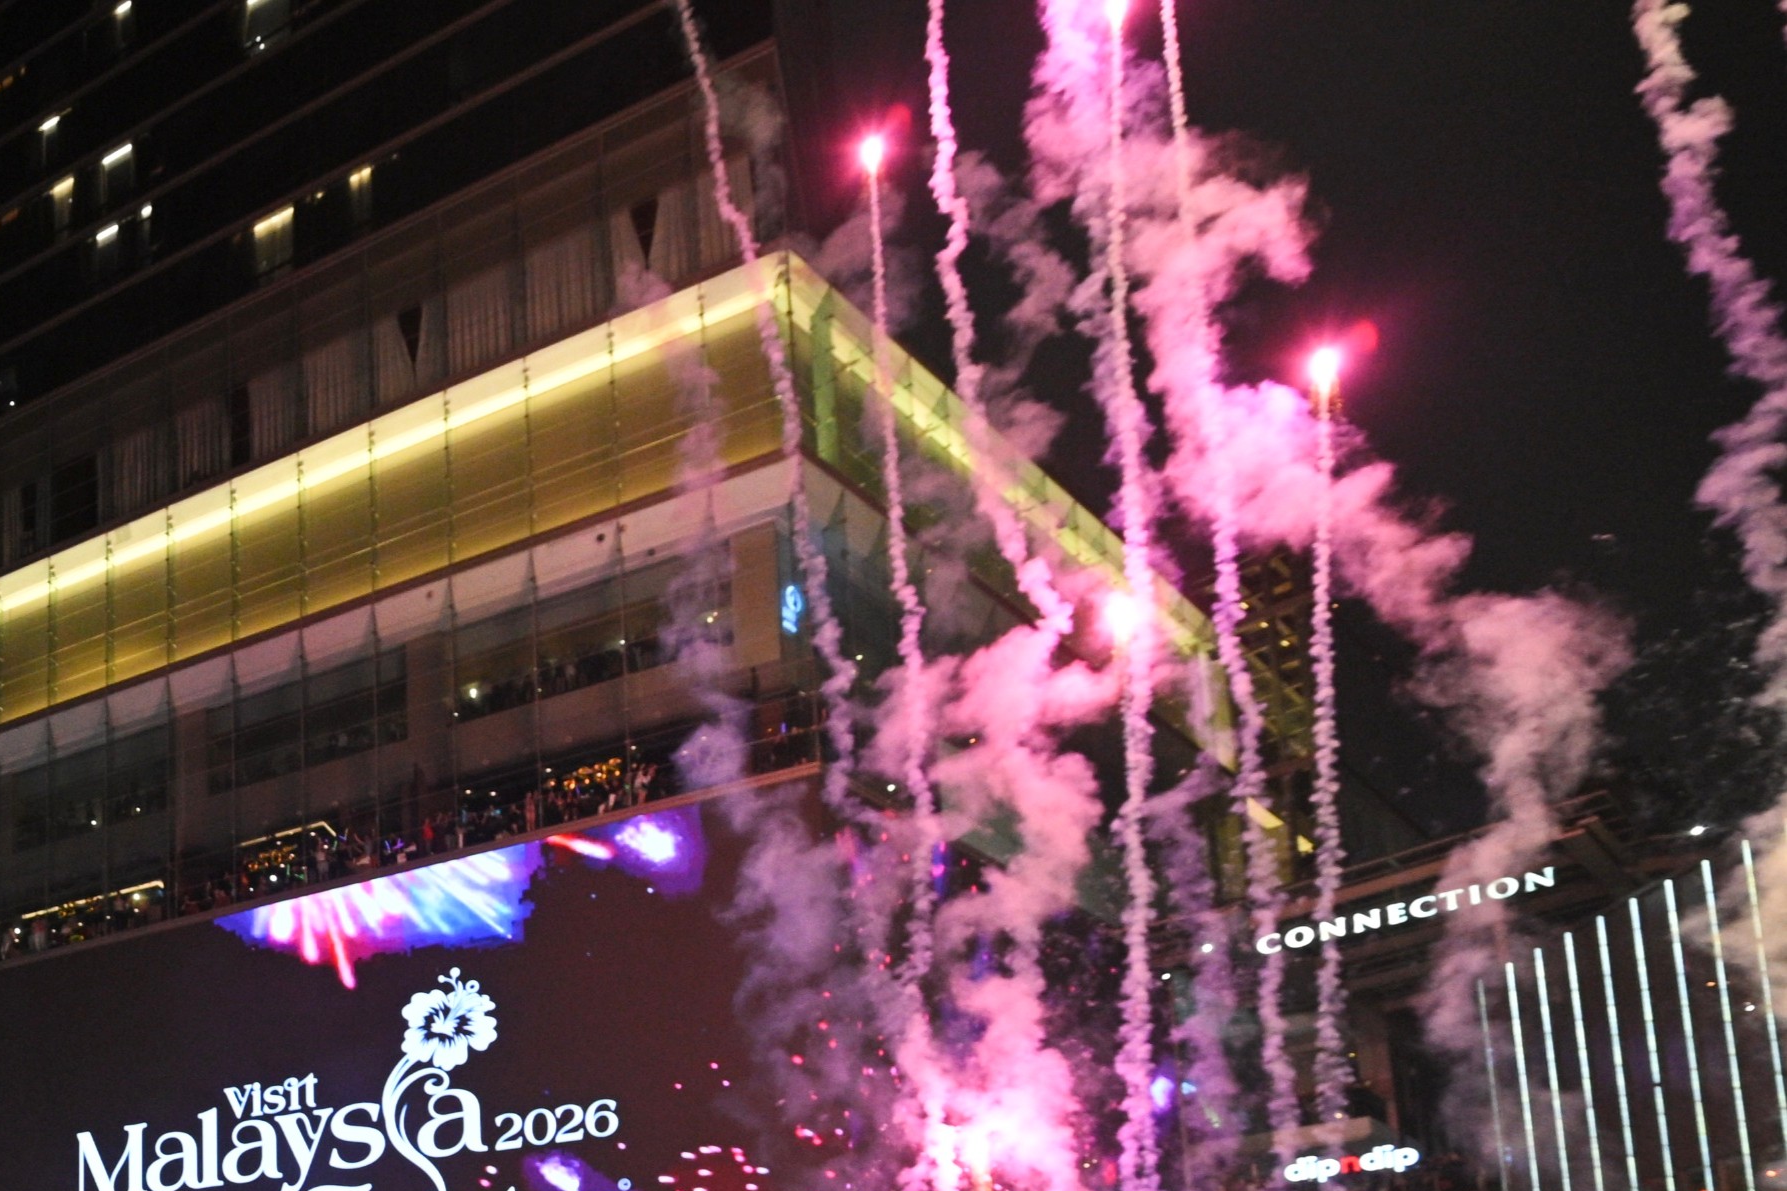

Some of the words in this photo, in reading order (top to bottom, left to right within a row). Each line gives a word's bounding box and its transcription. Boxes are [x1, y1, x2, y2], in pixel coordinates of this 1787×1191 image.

[1255, 865, 1557, 955] CONNECTION
[223, 1072, 319, 1120] Visit
[494, 1099, 620, 1152] 2026
[1284, 1143, 1420, 1183] dipndip
